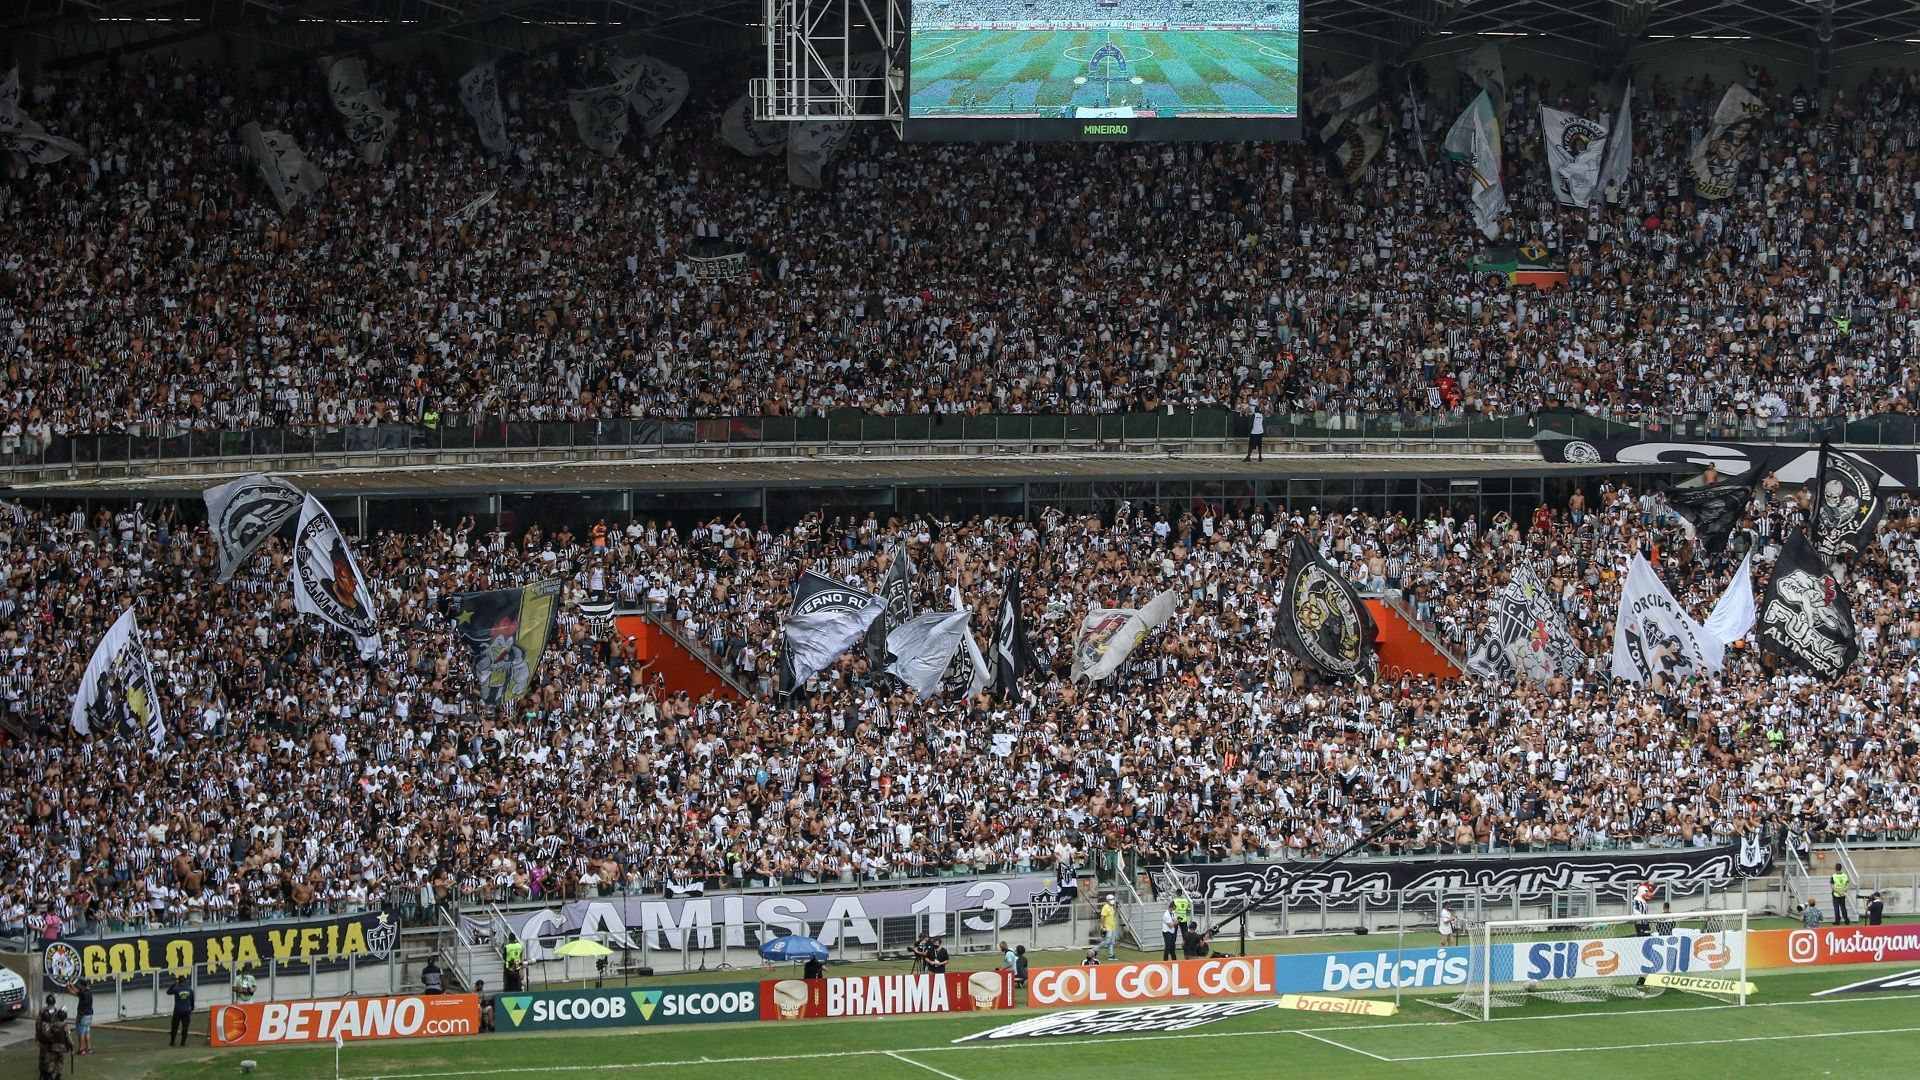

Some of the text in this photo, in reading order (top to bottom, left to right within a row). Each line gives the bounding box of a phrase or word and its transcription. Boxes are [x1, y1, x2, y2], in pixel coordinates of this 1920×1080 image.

[1508, 604, 1535, 630] CAM
[1764, 626, 1839, 680] ALVINEGRA
[912, 881, 1013, 937] 13
[1033, 895, 1058, 904] CAM
[206, 934, 262, 975] NA
[1527, 936, 1691, 980] Sil Sil
[1825, 930, 1920, 962] Instagram
[1032, 968, 1107, 1004] GOL
[1115, 963, 1190, 999] GOL
[1198, 959, 1271, 995] GOL
[1322, 949, 1468, 991] betcris
[1661, 974, 1736, 992] quartzolit
[533, 991, 755, 1022] SICOOB SICOOB
[826, 973, 949, 1017] BRAHMA
[1296, 997, 1372, 1015] brasilit
